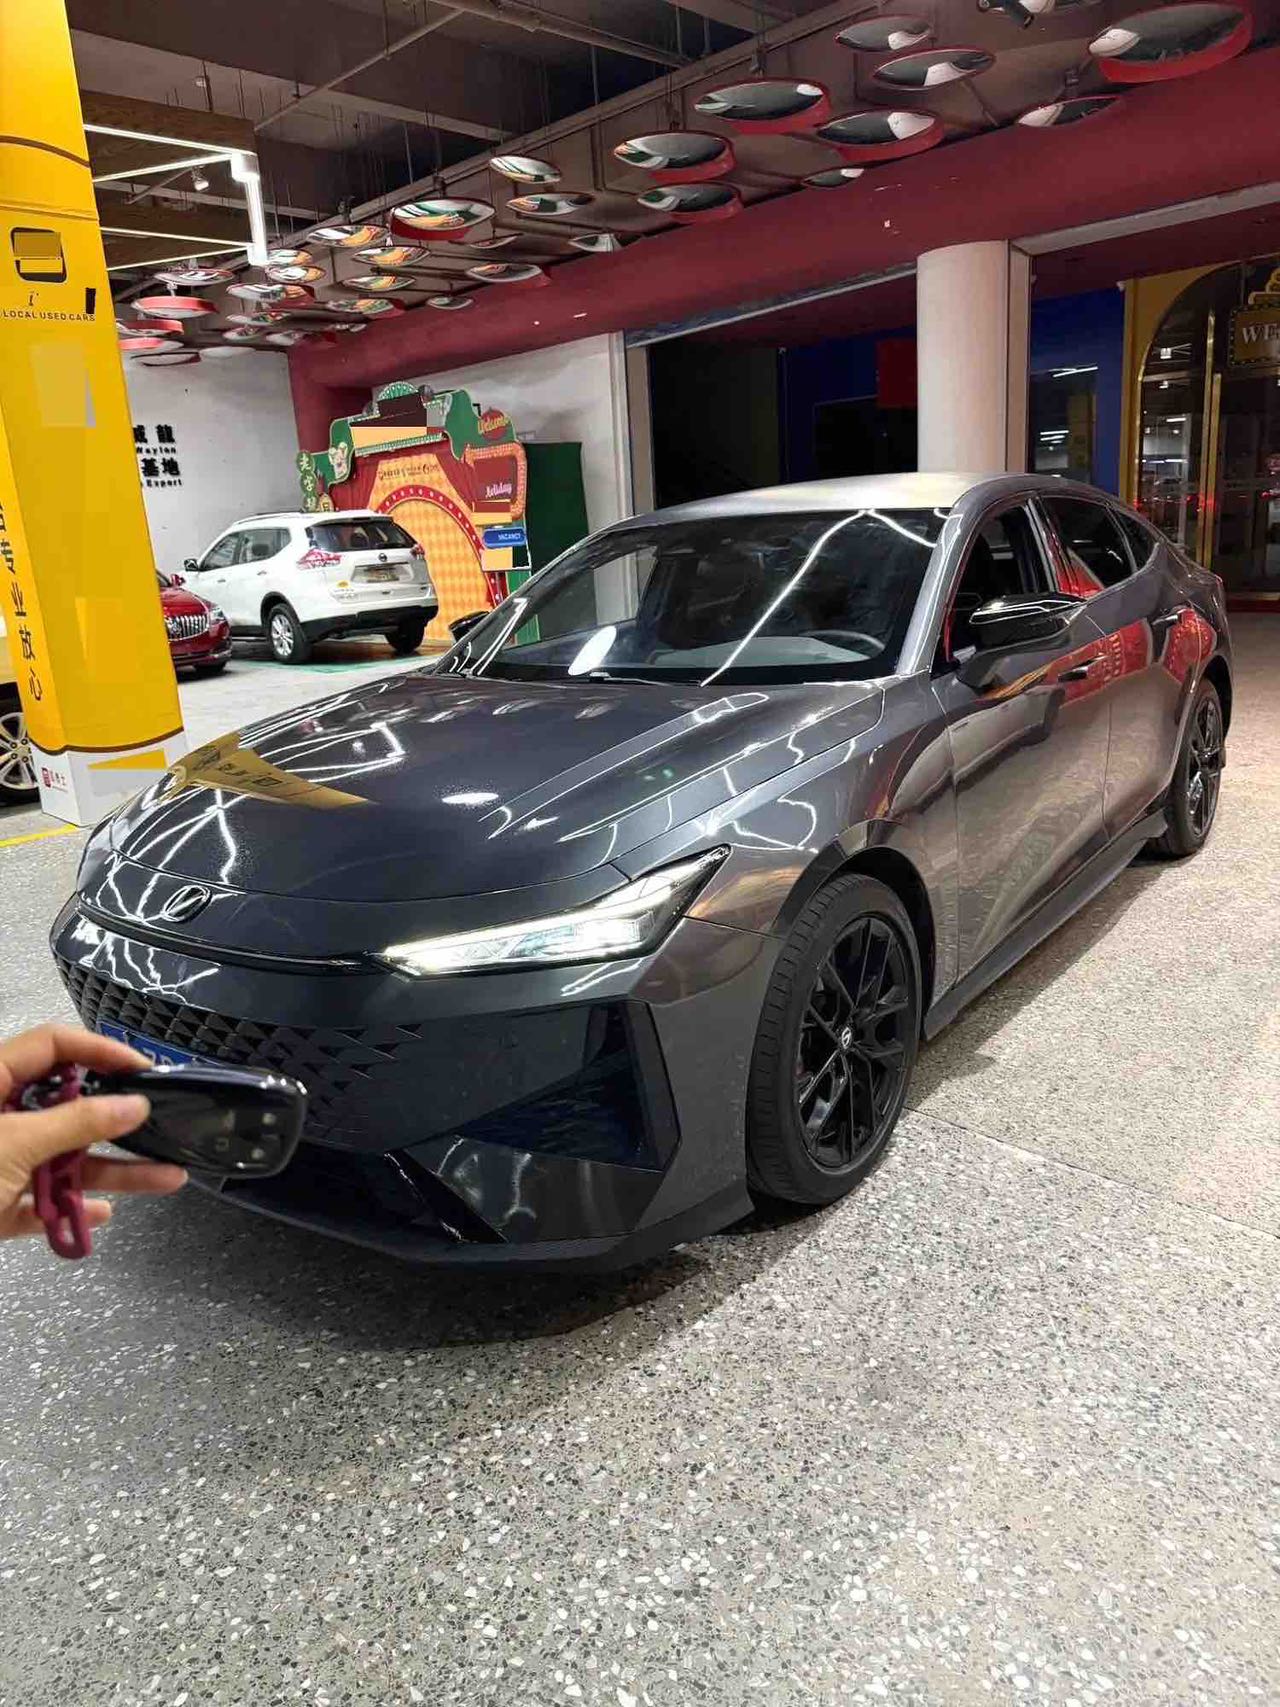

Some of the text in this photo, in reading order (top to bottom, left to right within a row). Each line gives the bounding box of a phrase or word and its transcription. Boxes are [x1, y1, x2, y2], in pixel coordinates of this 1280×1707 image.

[3, 310, 96, 321] LOCAL USED CARS
[141, 457, 180, 477] 基地
